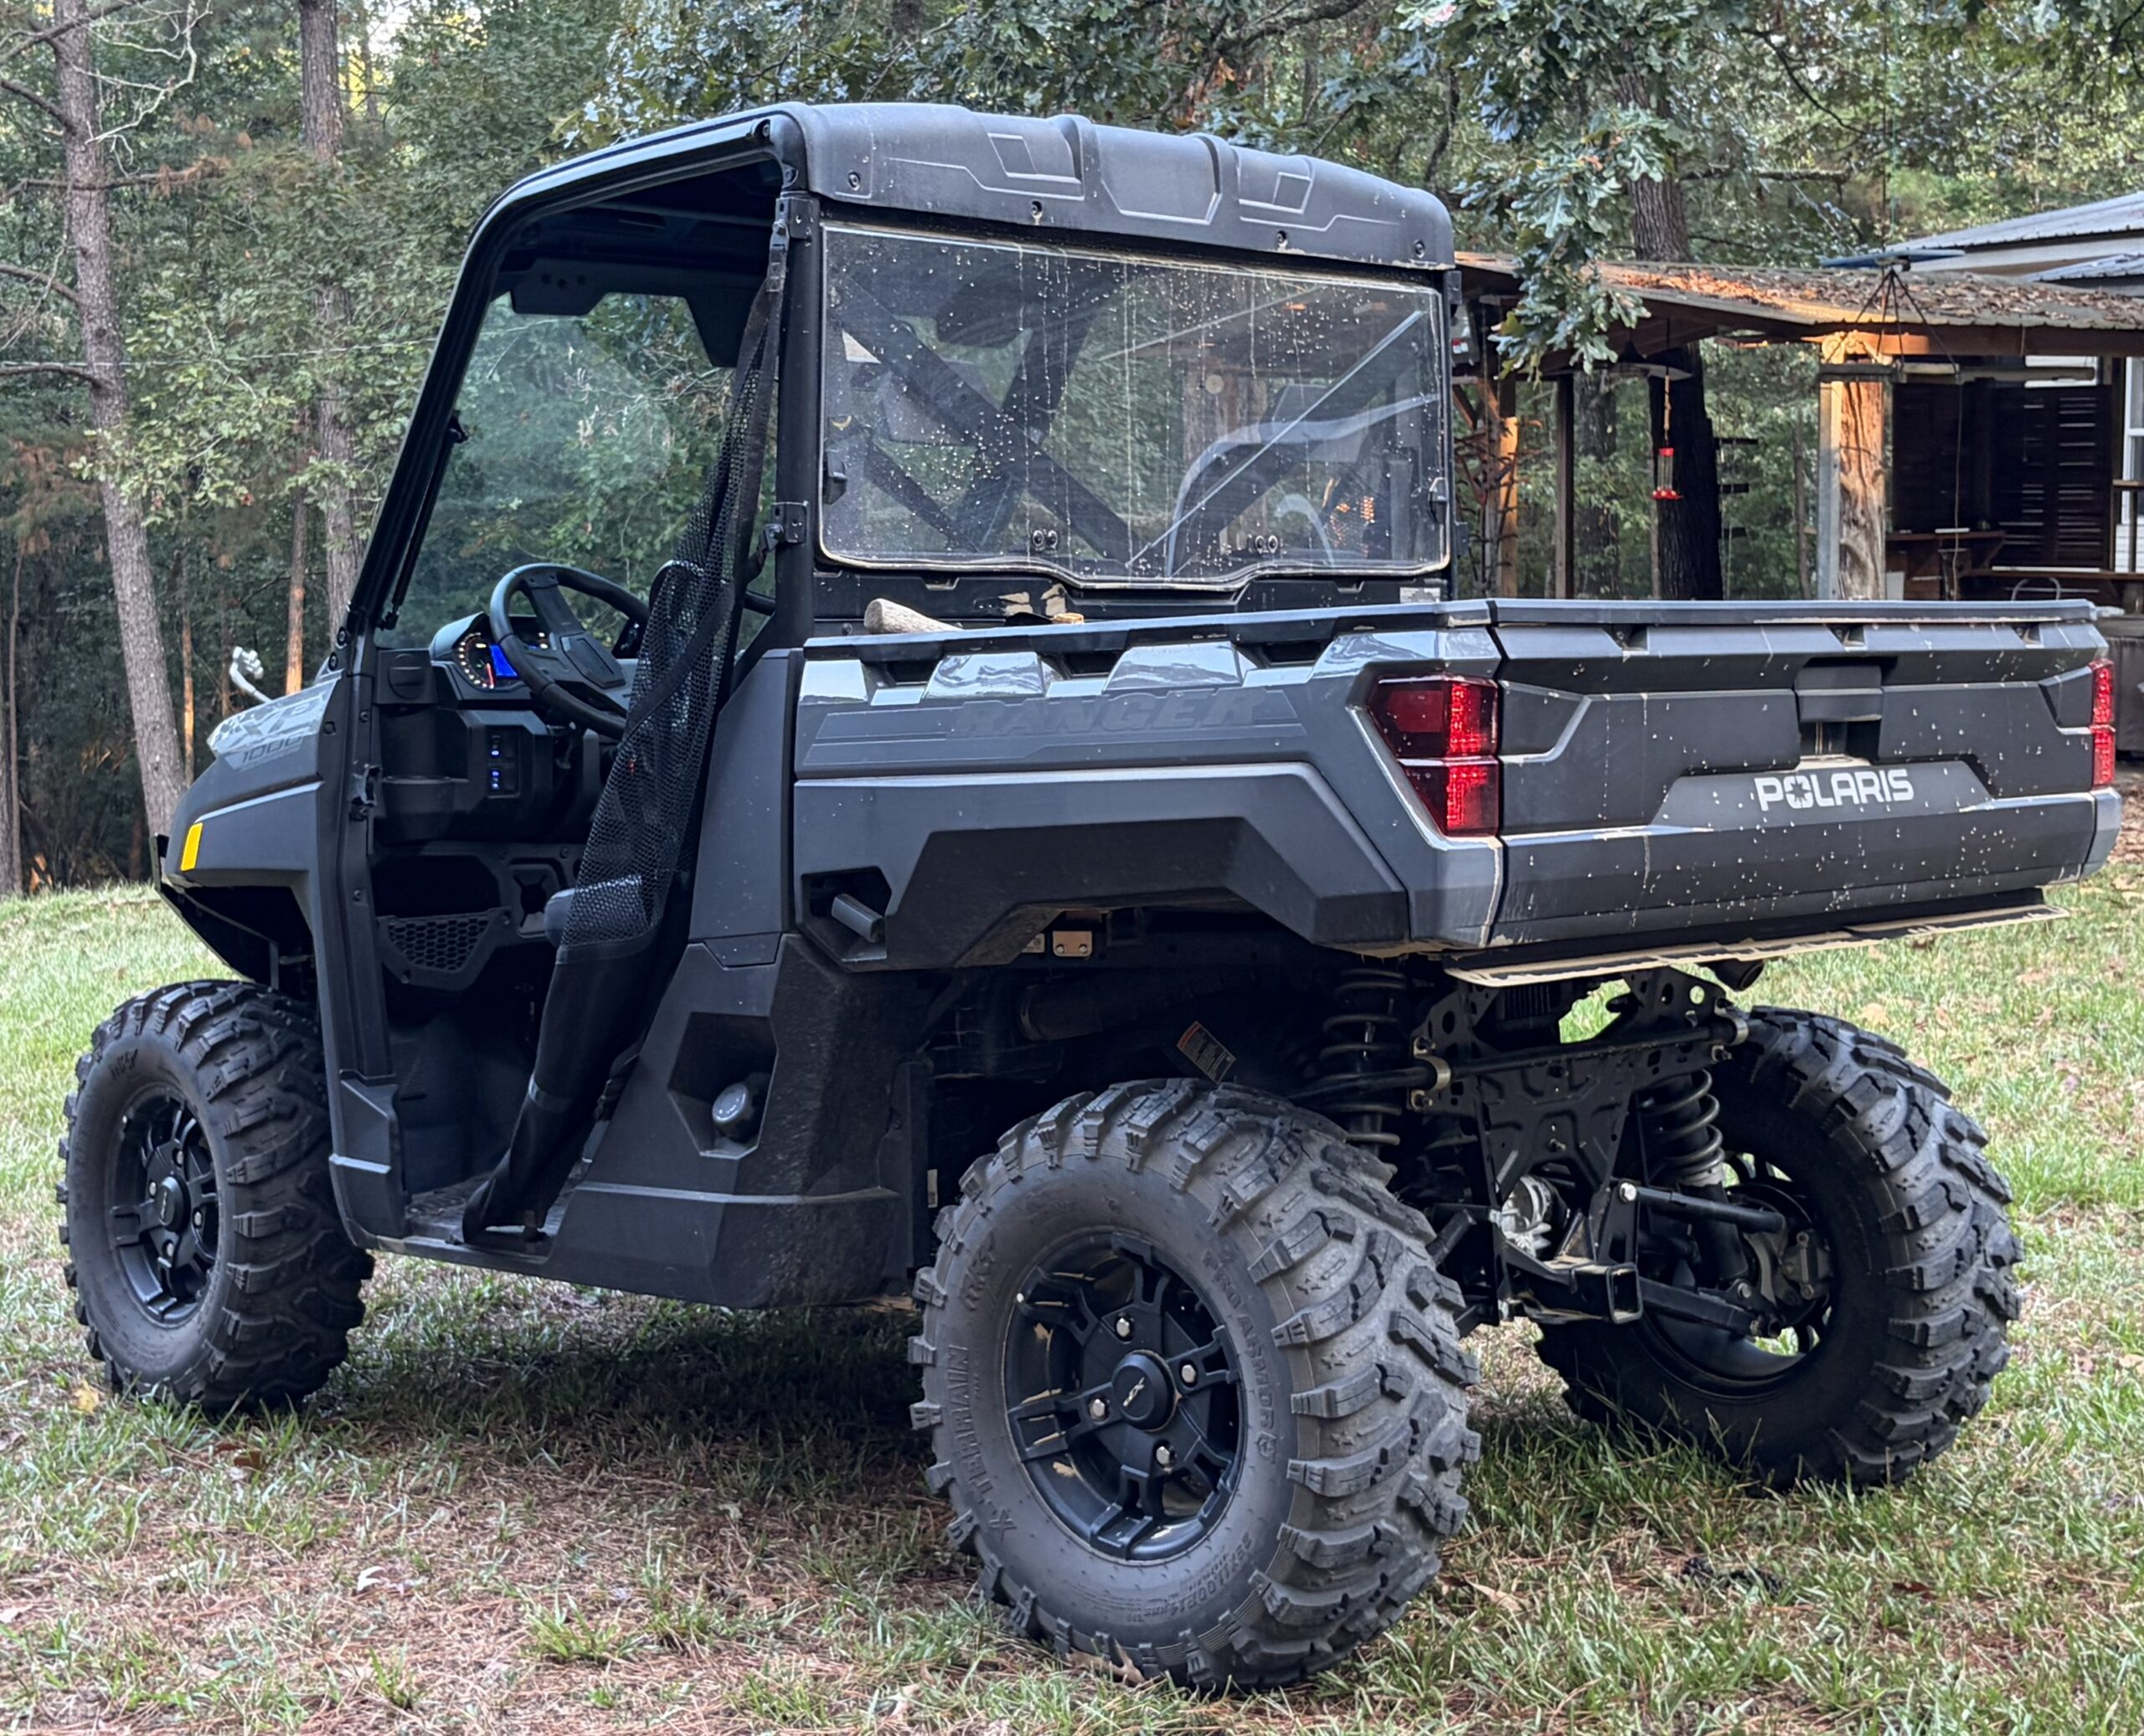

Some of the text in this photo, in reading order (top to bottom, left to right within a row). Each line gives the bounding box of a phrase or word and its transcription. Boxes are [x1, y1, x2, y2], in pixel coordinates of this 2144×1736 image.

[956, 687, 1267, 739] RANGER
[241, 734, 303, 764] 1000
[1754, 769, 1915, 811] POLARIS
[1236, 1314, 1275, 1429] ARMOR
[947, 1344, 1018, 1542] X-TERRAIN
